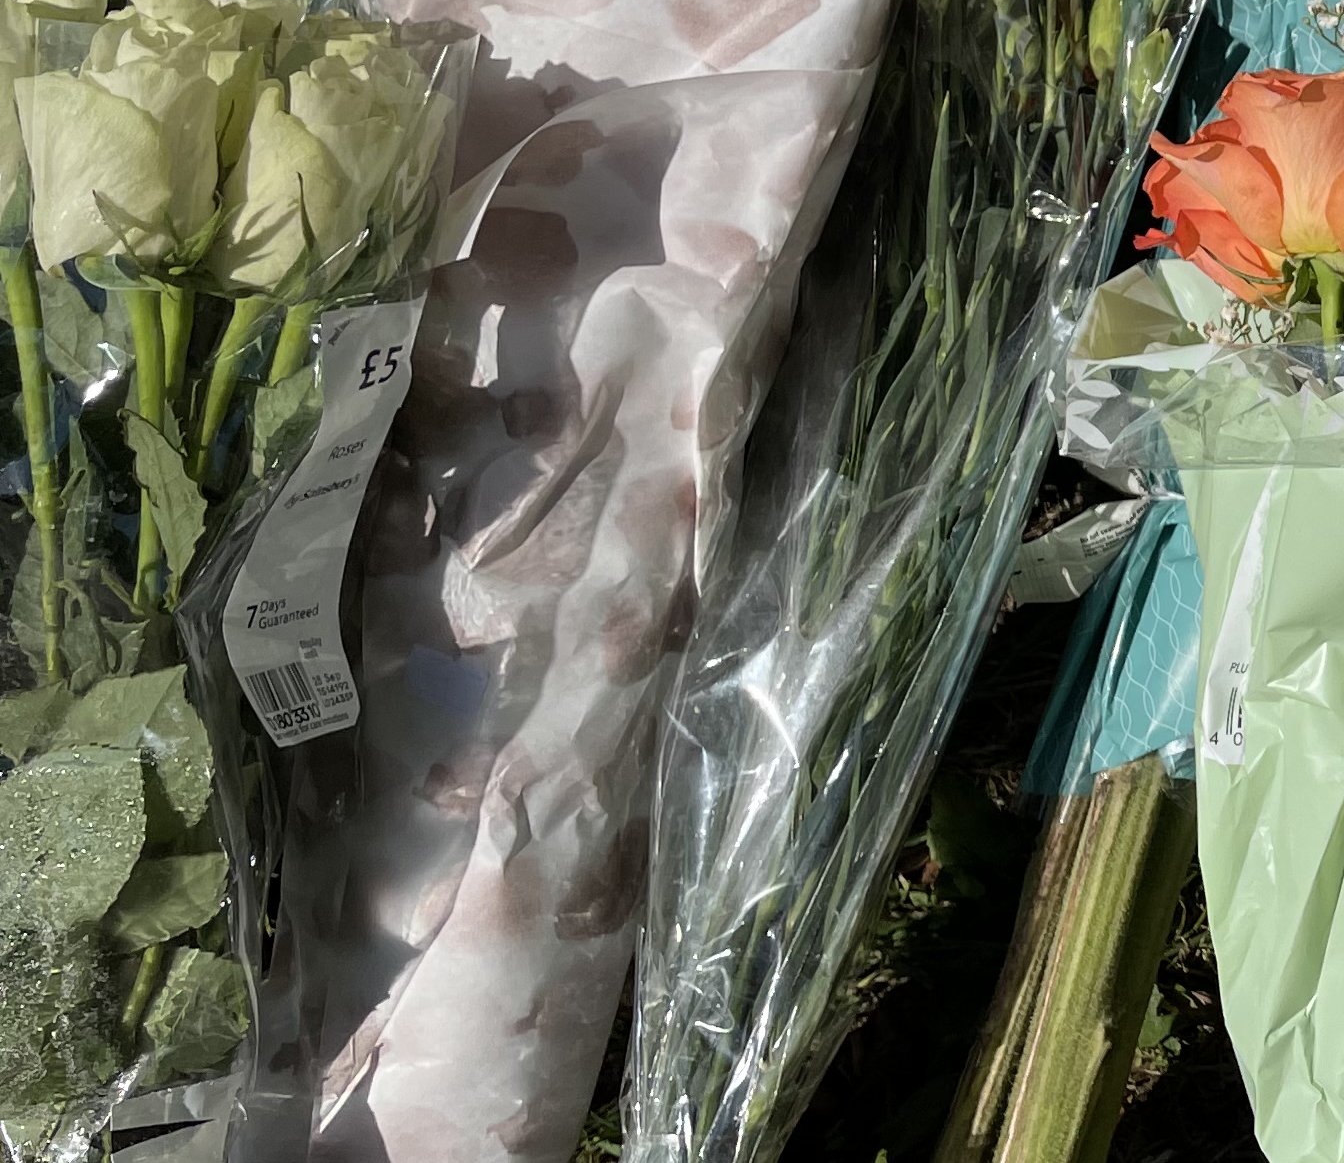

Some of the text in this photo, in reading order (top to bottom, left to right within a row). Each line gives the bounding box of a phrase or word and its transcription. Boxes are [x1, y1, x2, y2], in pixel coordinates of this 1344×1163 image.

[358, 345, 404, 391] £5
[246, 598, 286, 629] 7 Days
[258, 602, 319, 629] Guaranteed
[1229, 662, 1249, 674] PLU
[1209, 731, 1219, 746] 4
